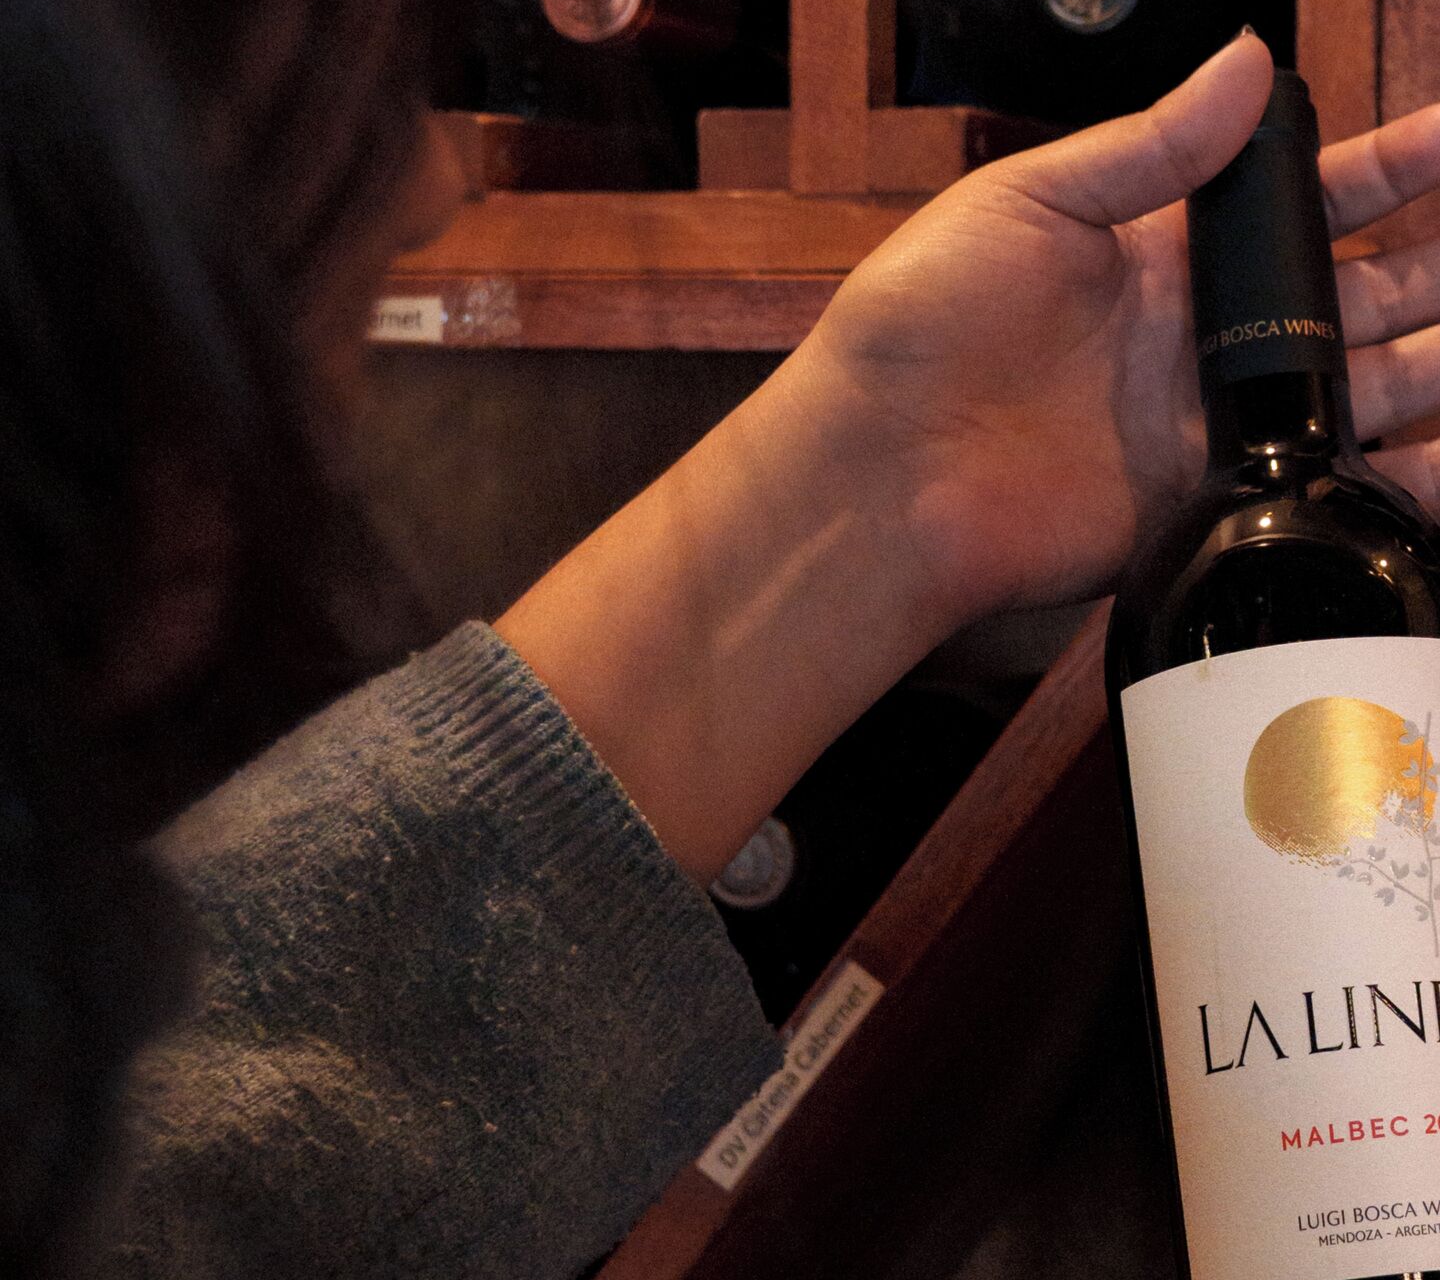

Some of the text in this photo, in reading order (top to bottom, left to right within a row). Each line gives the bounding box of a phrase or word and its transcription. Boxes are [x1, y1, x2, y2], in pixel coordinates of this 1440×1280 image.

[1220, 320, 1281, 348] BOSCA
[1284, 319, 1336, 340] WINES
[1197, 999, 1289, 1076] LA
[718, 982, 870, 1169] DV Catena Cabernet
[1280, 1115, 1409, 1151] MALBEC
[1298, 1209, 1346, 1232] LUIGI
[1353, 1201, 1417, 1224] BOSCA
[1318, 1228, 1383, 1247] MENDOZA
